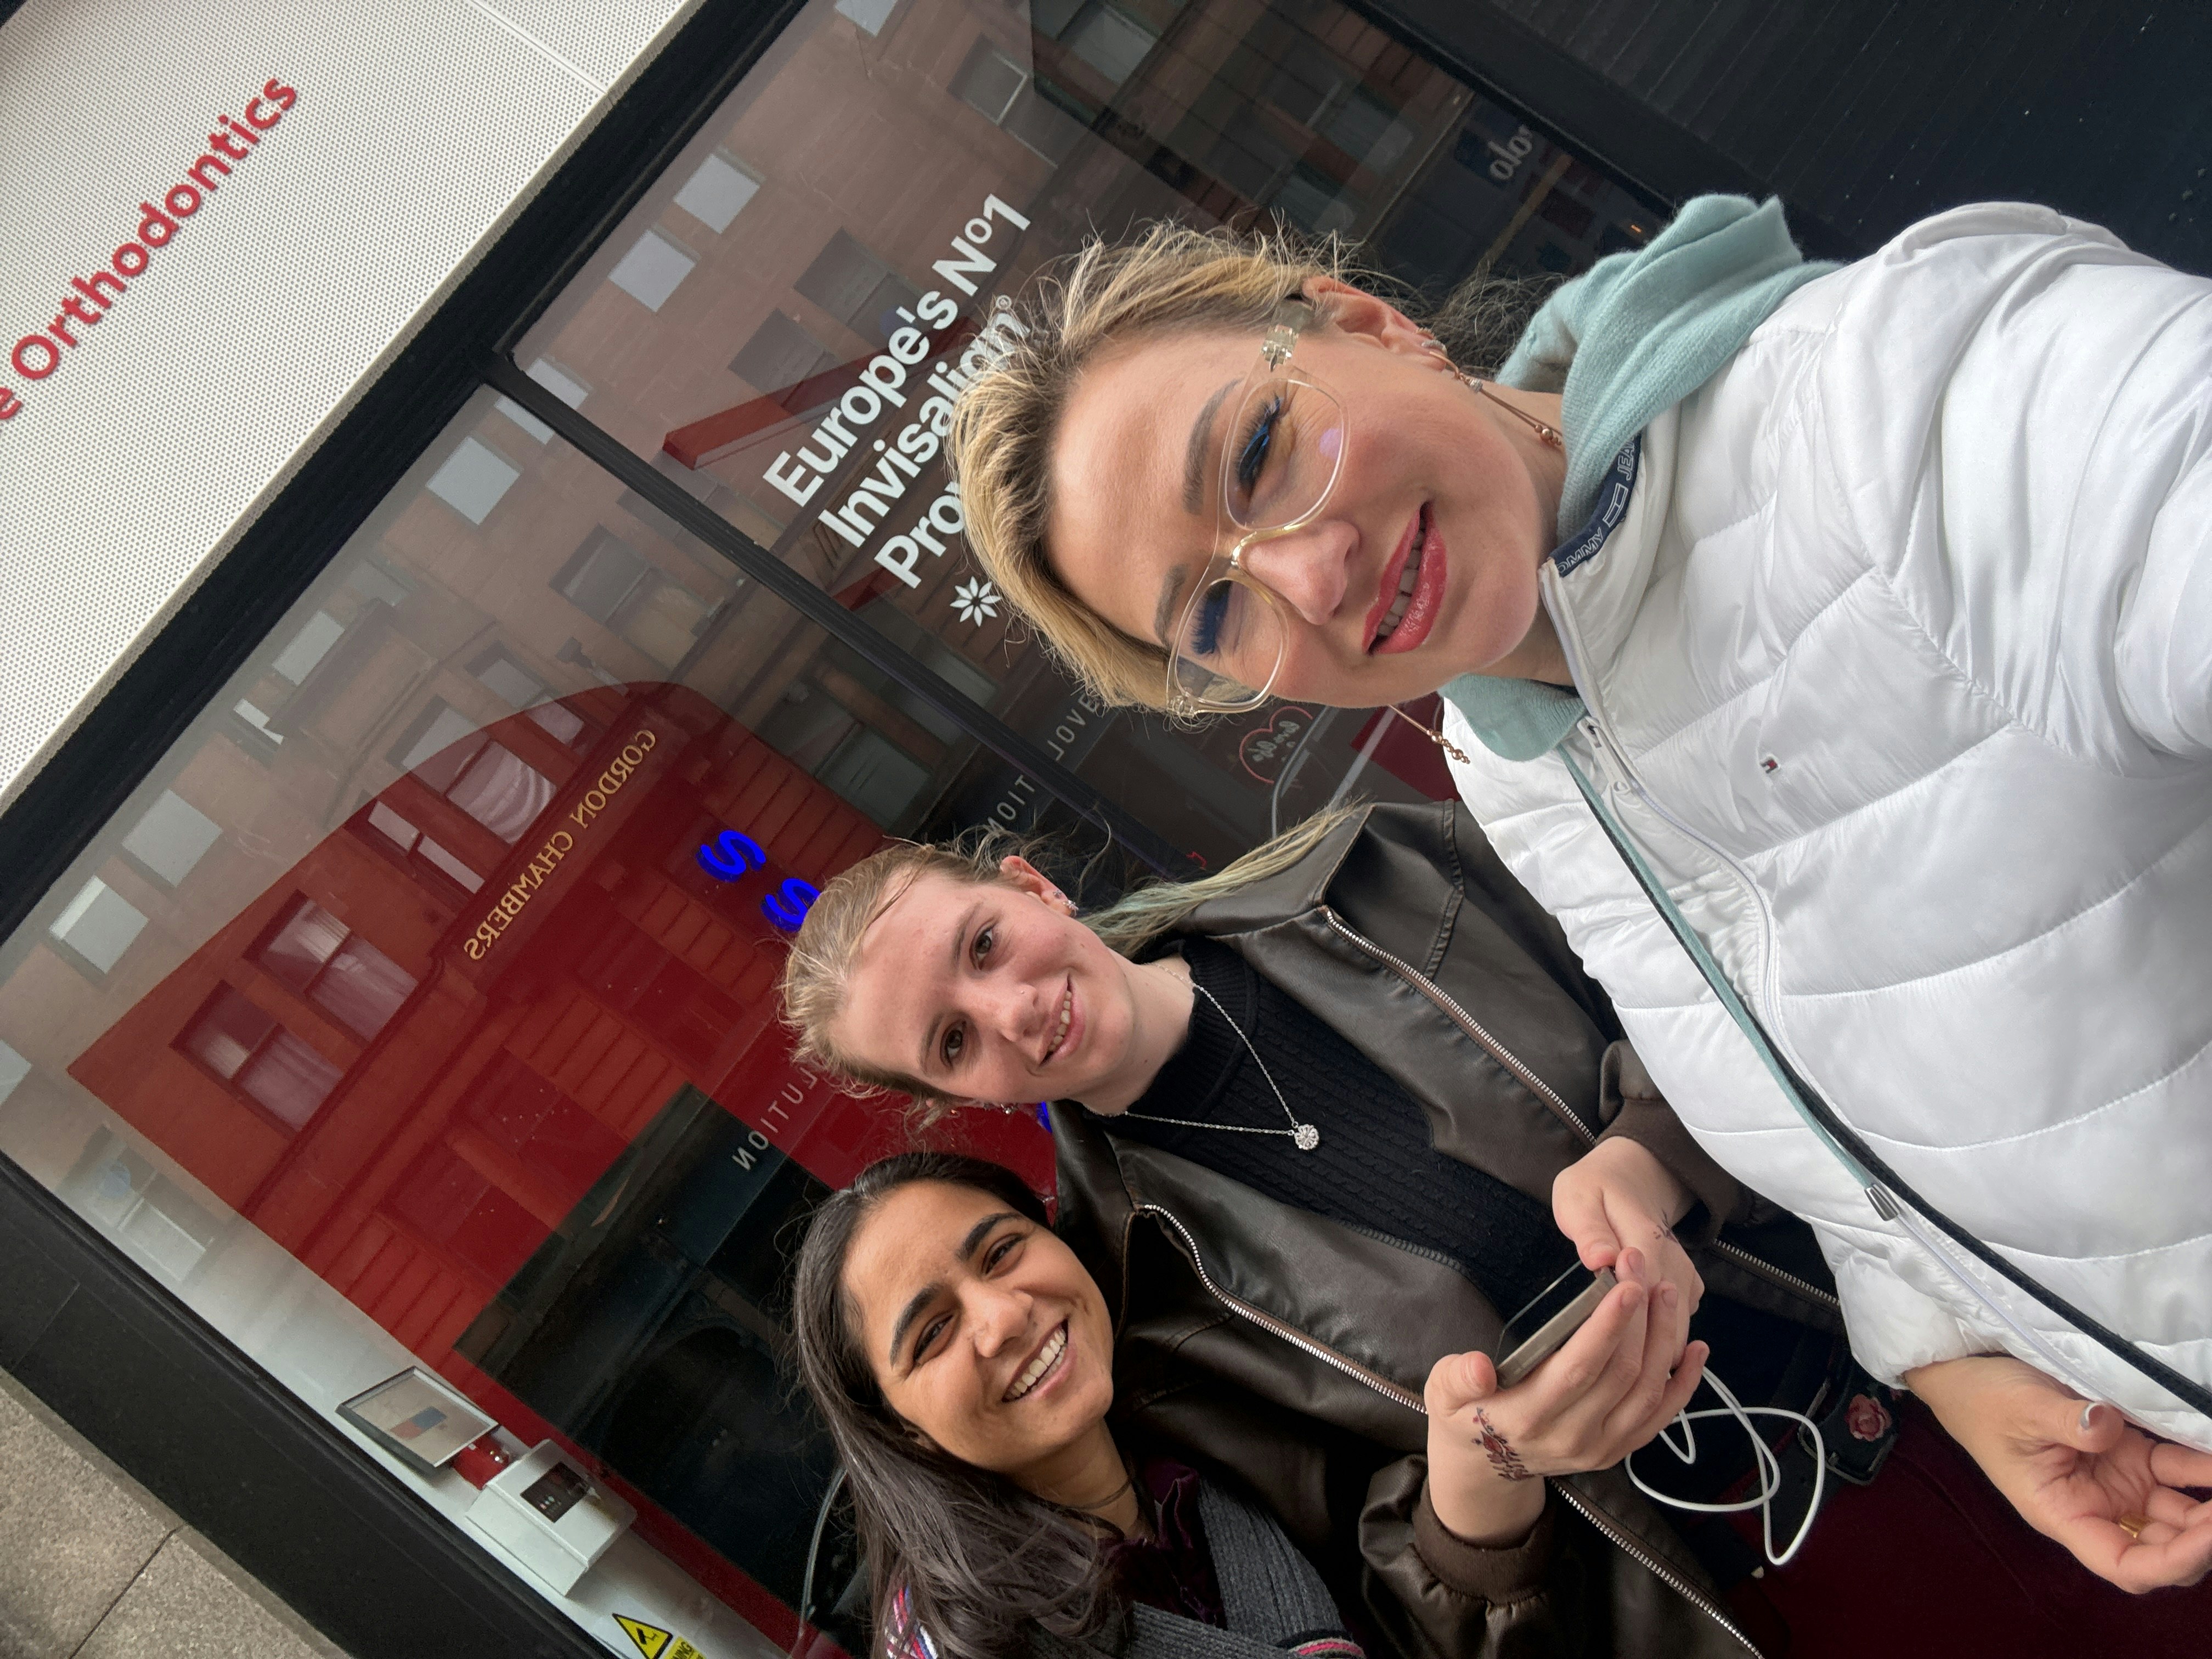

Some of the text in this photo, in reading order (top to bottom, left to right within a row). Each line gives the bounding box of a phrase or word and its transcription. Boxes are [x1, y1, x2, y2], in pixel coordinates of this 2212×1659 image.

[11, 77, 297, 380] Orthodontics
[763, 290, 958, 507] Europe's
[873, 481, 966, 589] Pro
[1557, 440, 1635, 573] OMMY JEA
